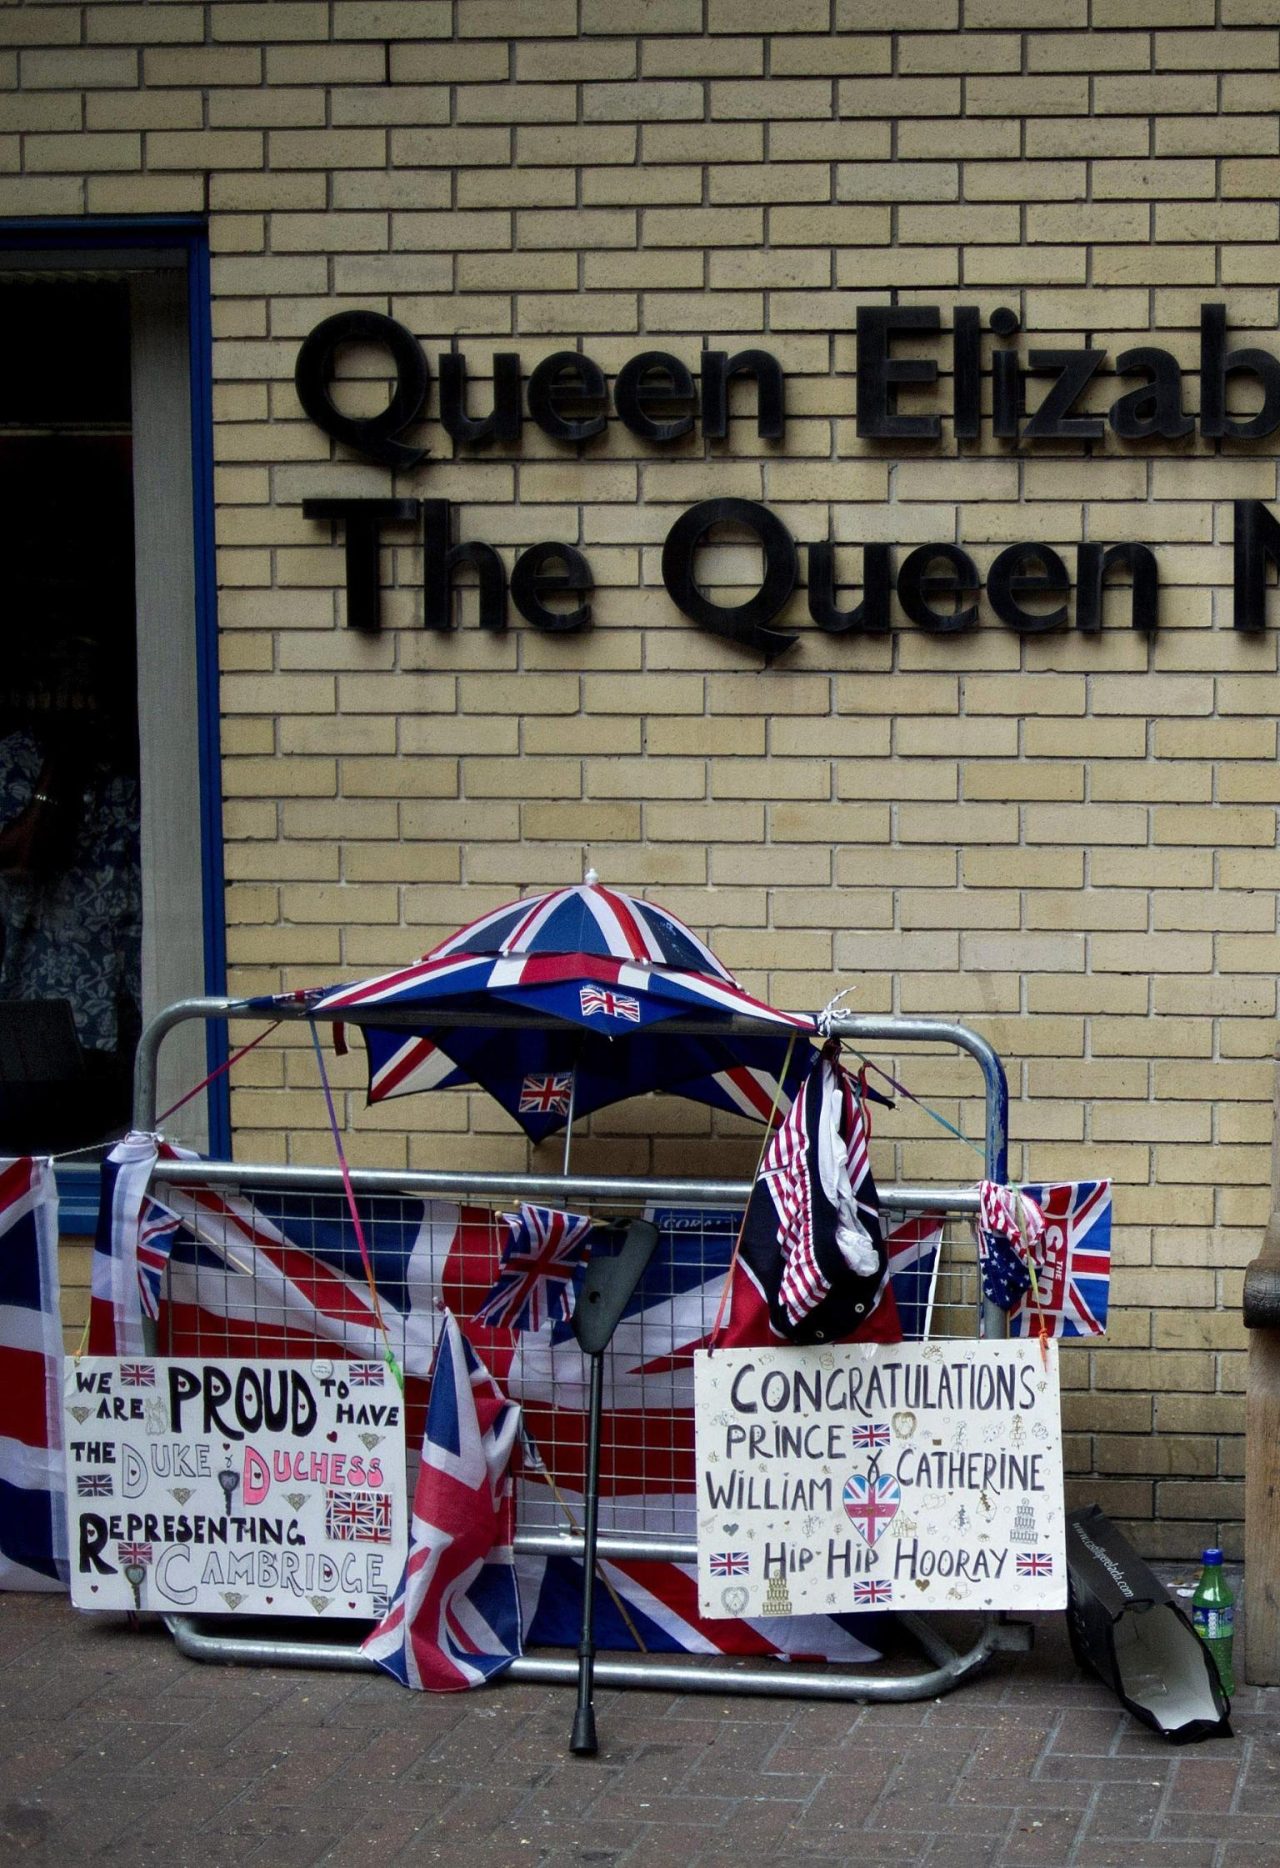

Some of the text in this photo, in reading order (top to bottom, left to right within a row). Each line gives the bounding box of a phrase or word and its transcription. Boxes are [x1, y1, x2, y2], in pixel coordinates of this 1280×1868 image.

[295, 310, 785, 470] Queen
[303, 498, 594, 633] The
[662, 498, 1158, 657] Queen
[1055, 1261, 1064, 1281] THE
[76, 1372, 112, 1394] WE
[96, 1398, 144, 1421] ARE
[168, 1366, 317, 1441] PROUD
[320, 1379, 349, 1399] TO
[336, 1404, 398, 1427] HAVE
[731, 1363, 1036, 1417] CONGRATULATIONS
[726, 1425, 846, 1459] PRINCE
[897, 1449, 1045, 1494] CATHERINE
[70, 1442, 115, 1464] THE
[122, 1444, 211, 1498] DUKE
[243, 1446, 384, 1505] DUCHESS
[80, 1513, 306, 1575] REPRESENTING
[155, 1544, 388, 1605] CAMBRIDGE
[894, 1538, 1009, 1582] HOORAY
